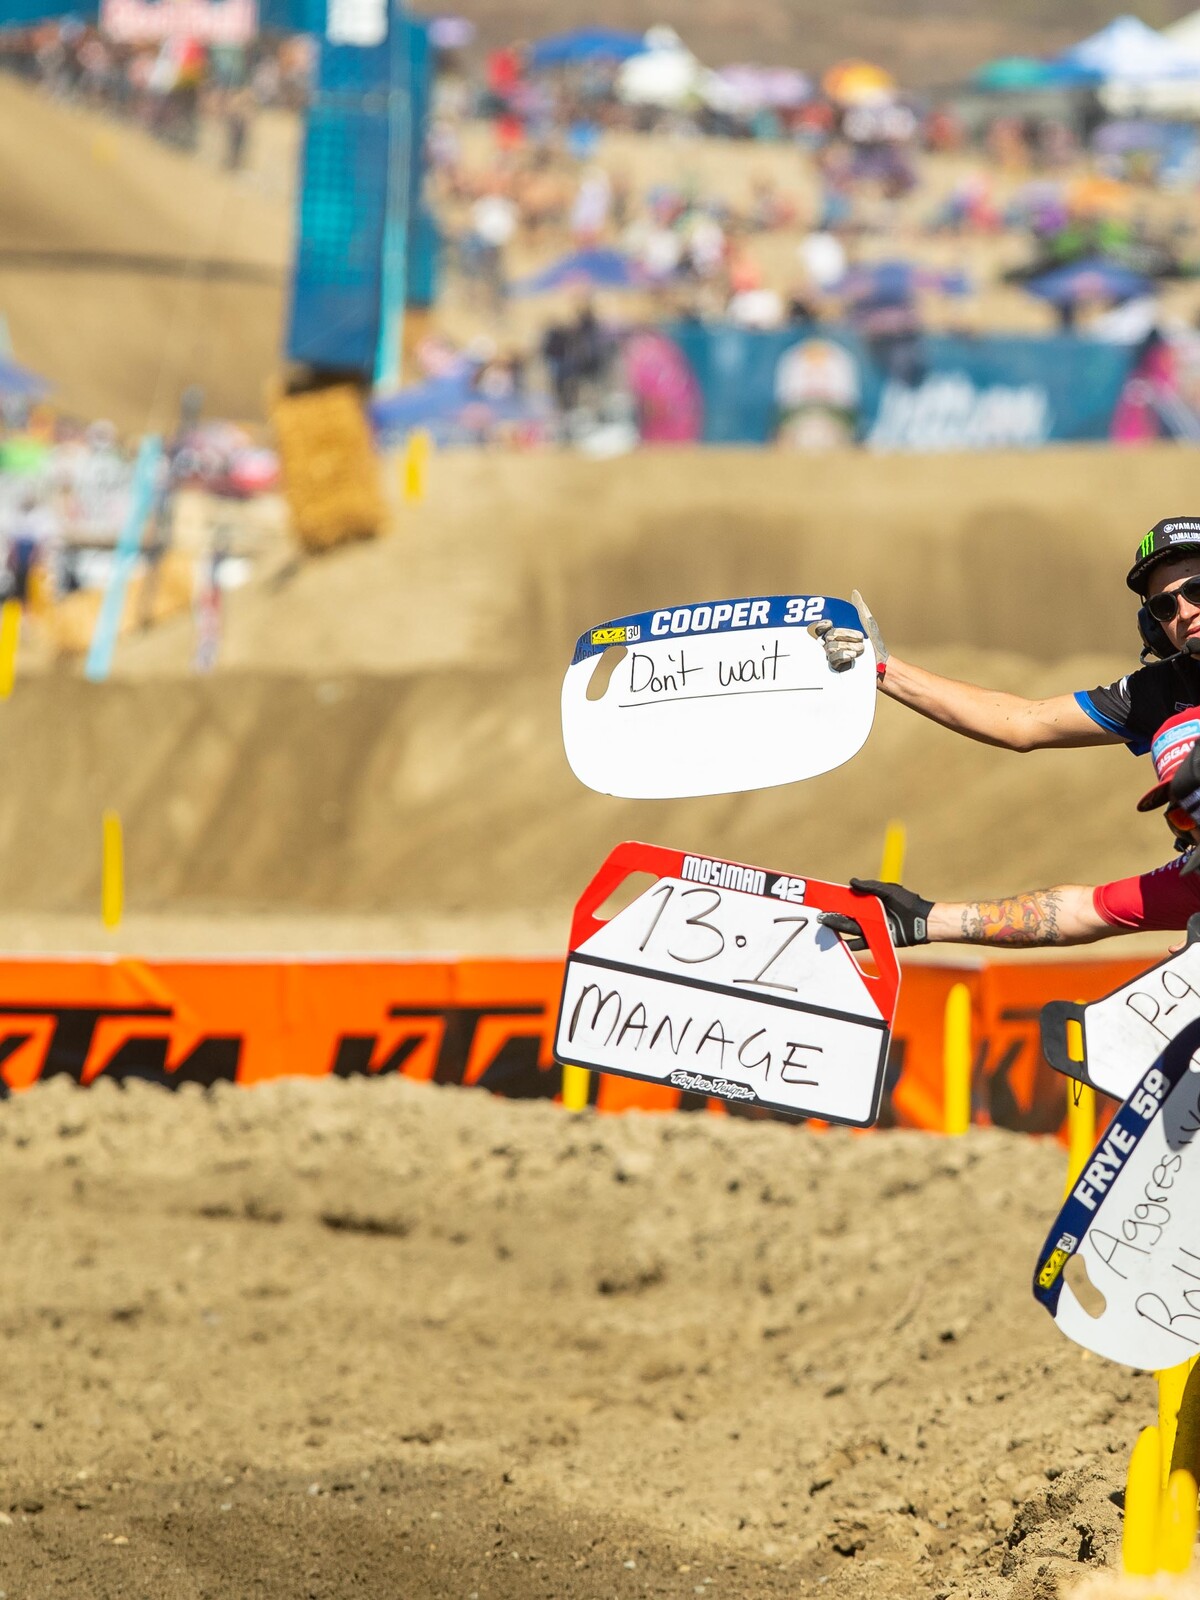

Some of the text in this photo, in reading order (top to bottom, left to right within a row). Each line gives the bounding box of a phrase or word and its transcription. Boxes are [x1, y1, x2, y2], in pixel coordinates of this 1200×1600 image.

[650, 596, 826, 636] COOPER 32
[630, 640, 790, 693] Don't wait
[681, 855, 807, 904] MOSIMAN 42
[569, 983, 823, 1086] MANAGE
[671, 1071, 756, 1100] Troy Lee Designs
[1073, 1068, 1171, 1211] FRYE 59
